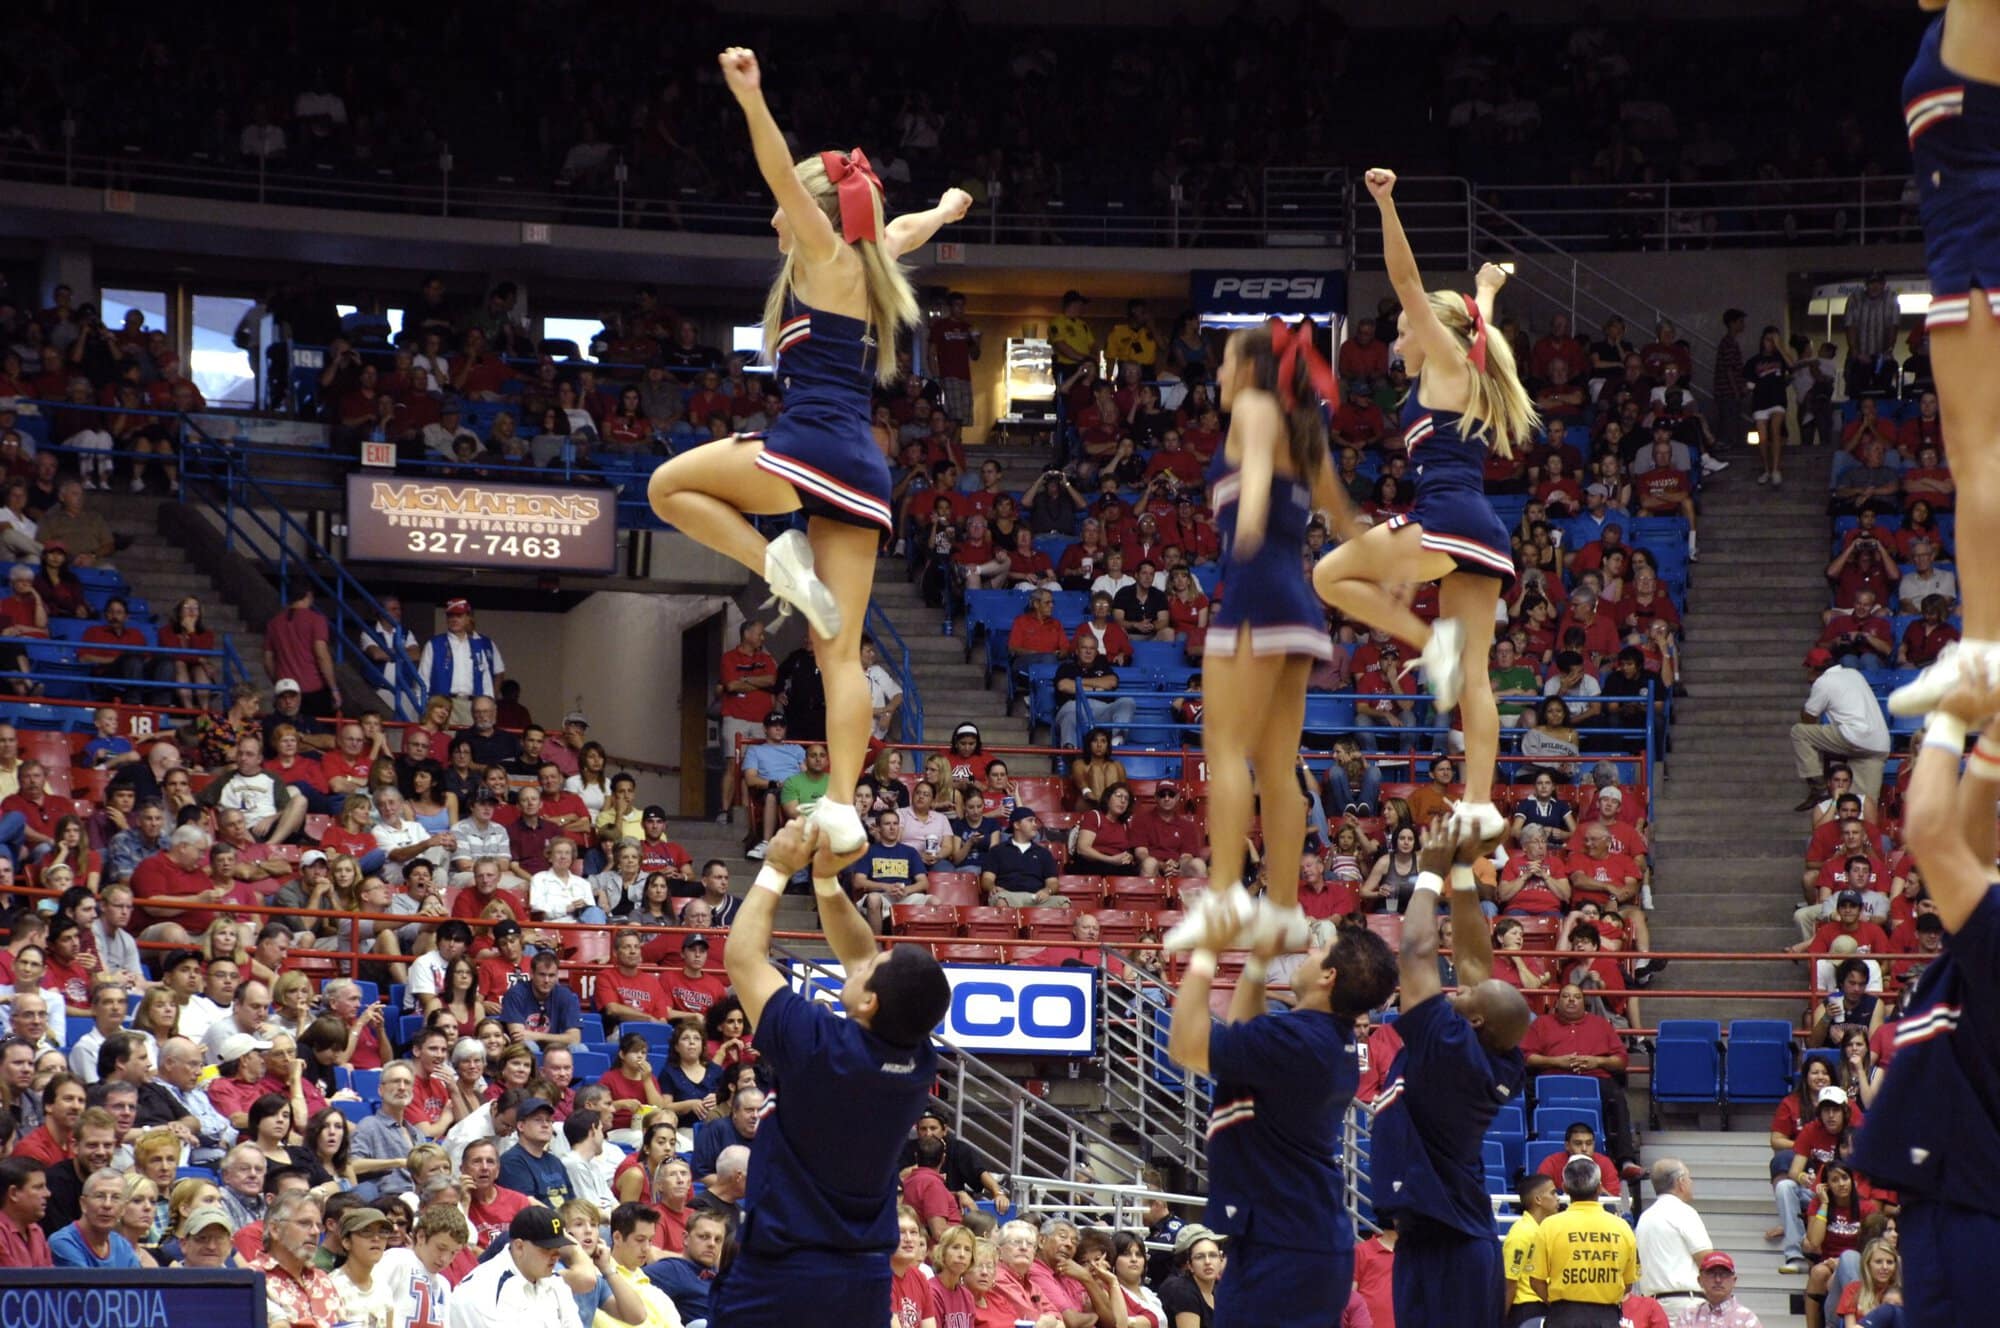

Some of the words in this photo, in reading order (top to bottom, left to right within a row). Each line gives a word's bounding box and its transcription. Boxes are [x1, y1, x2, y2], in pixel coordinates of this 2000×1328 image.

[1212, 277, 1325, 299] PEPSI
[367, 445, 391, 464] EXIT
[388, 515, 446, 529] PRIME
[458, 519, 582, 536] STEAKHOUSE
[408, 531, 561, 559] 327-7463
[130, 716, 153, 736] 18
[552, 1218, 562, 1234] P
[1568, 1232, 1620, 1244] EVENT
[1573, 1250, 1618, 1261] STAFF
[1562, 1268, 1620, 1284] SECURIT
[1, 1289, 168, 1328] CONCORDIA
